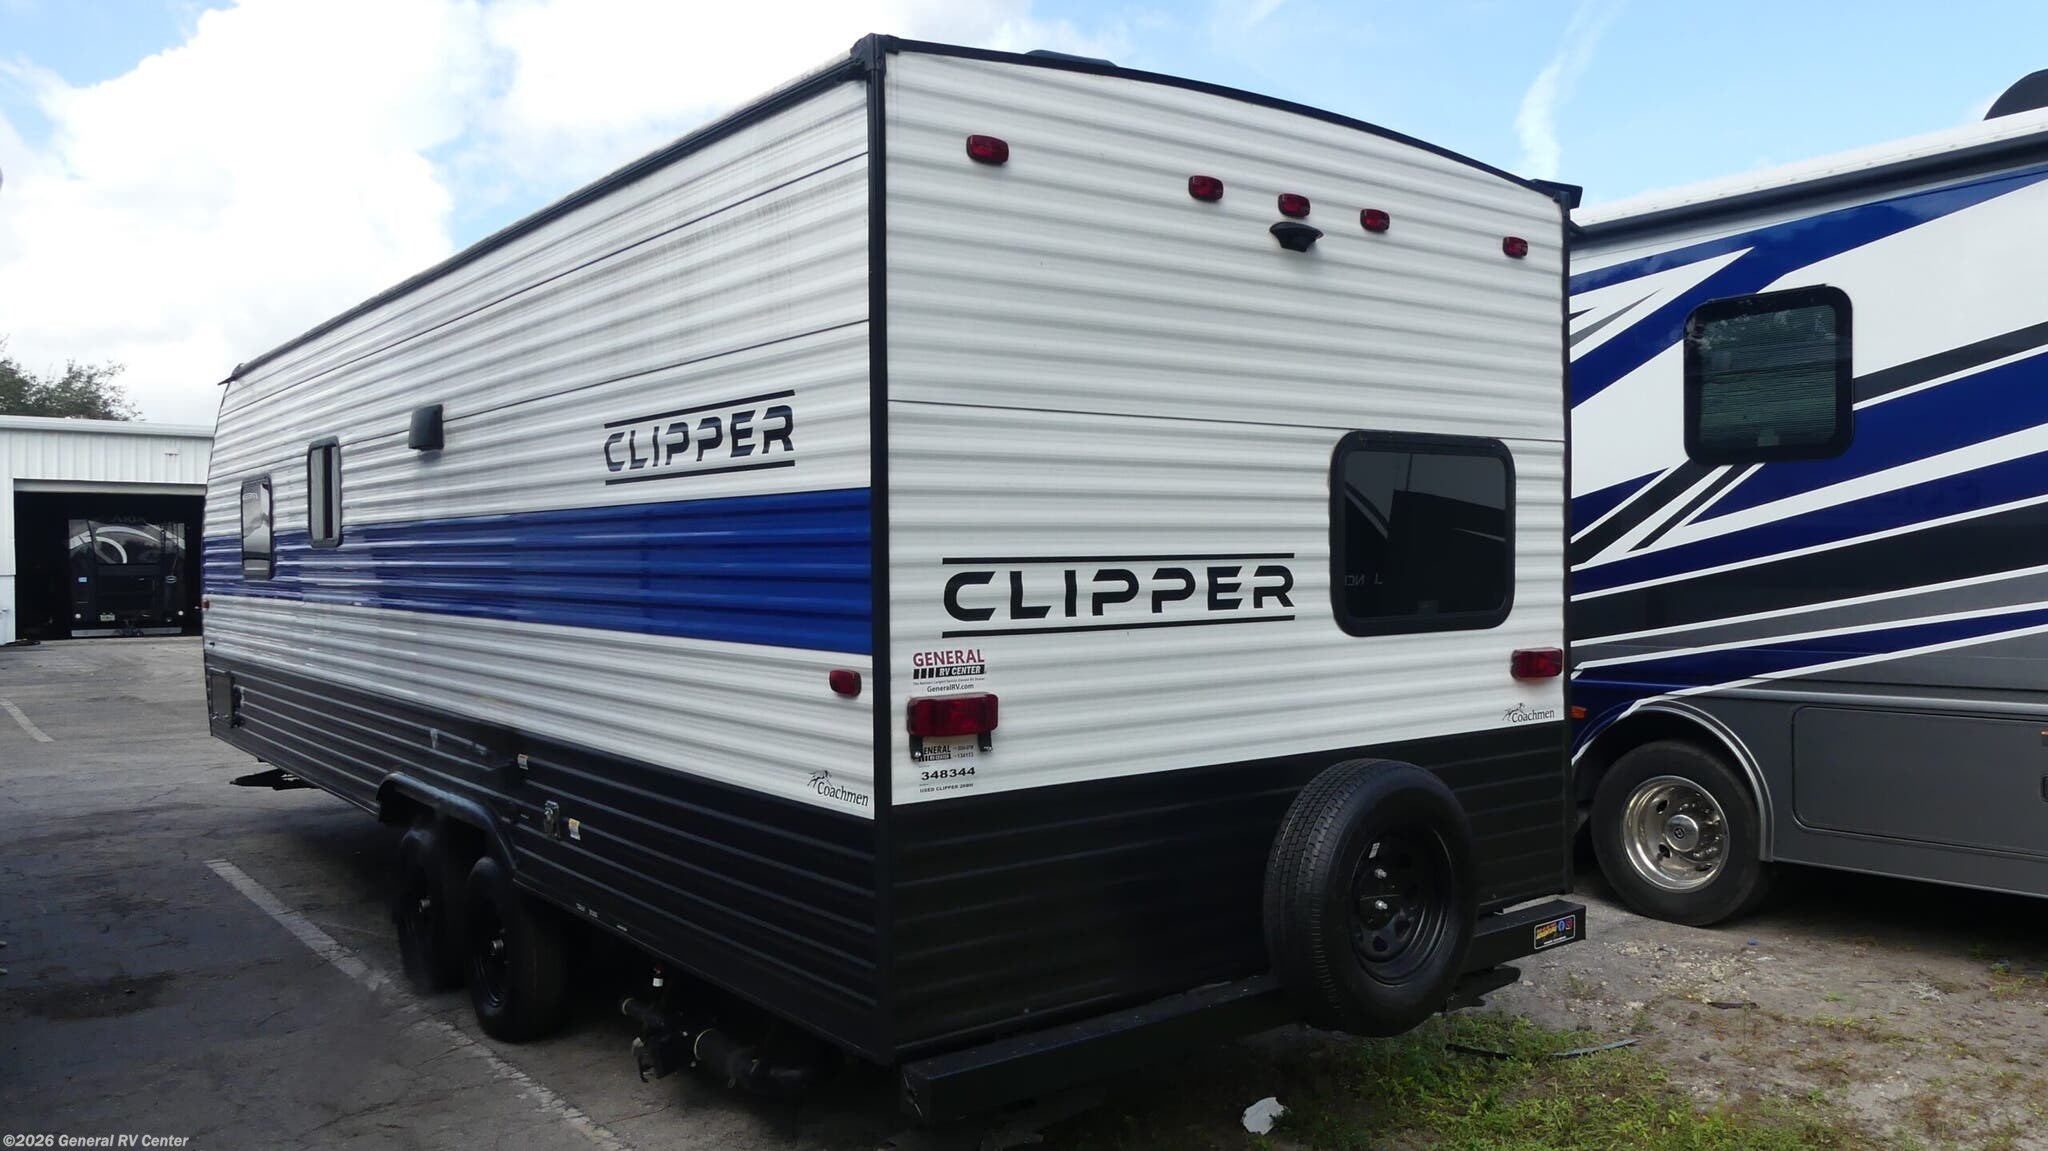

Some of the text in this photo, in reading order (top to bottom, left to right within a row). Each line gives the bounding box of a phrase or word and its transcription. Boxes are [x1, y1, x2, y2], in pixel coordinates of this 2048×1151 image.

[604, 405, 794, 472] CLIPPER
[943, 565, 1294, 622] CLIPPER
[913, 649, 985, 667] GENERAL
[939, 665, 981, 677] RV CENTER
[927, 683, 974, 693] GeneralRV.com
[1512, 709, 1555, 723] Coachmen
[921, 767, 976, 781] 348344
[817, 781, 869, 807] Coachmen
